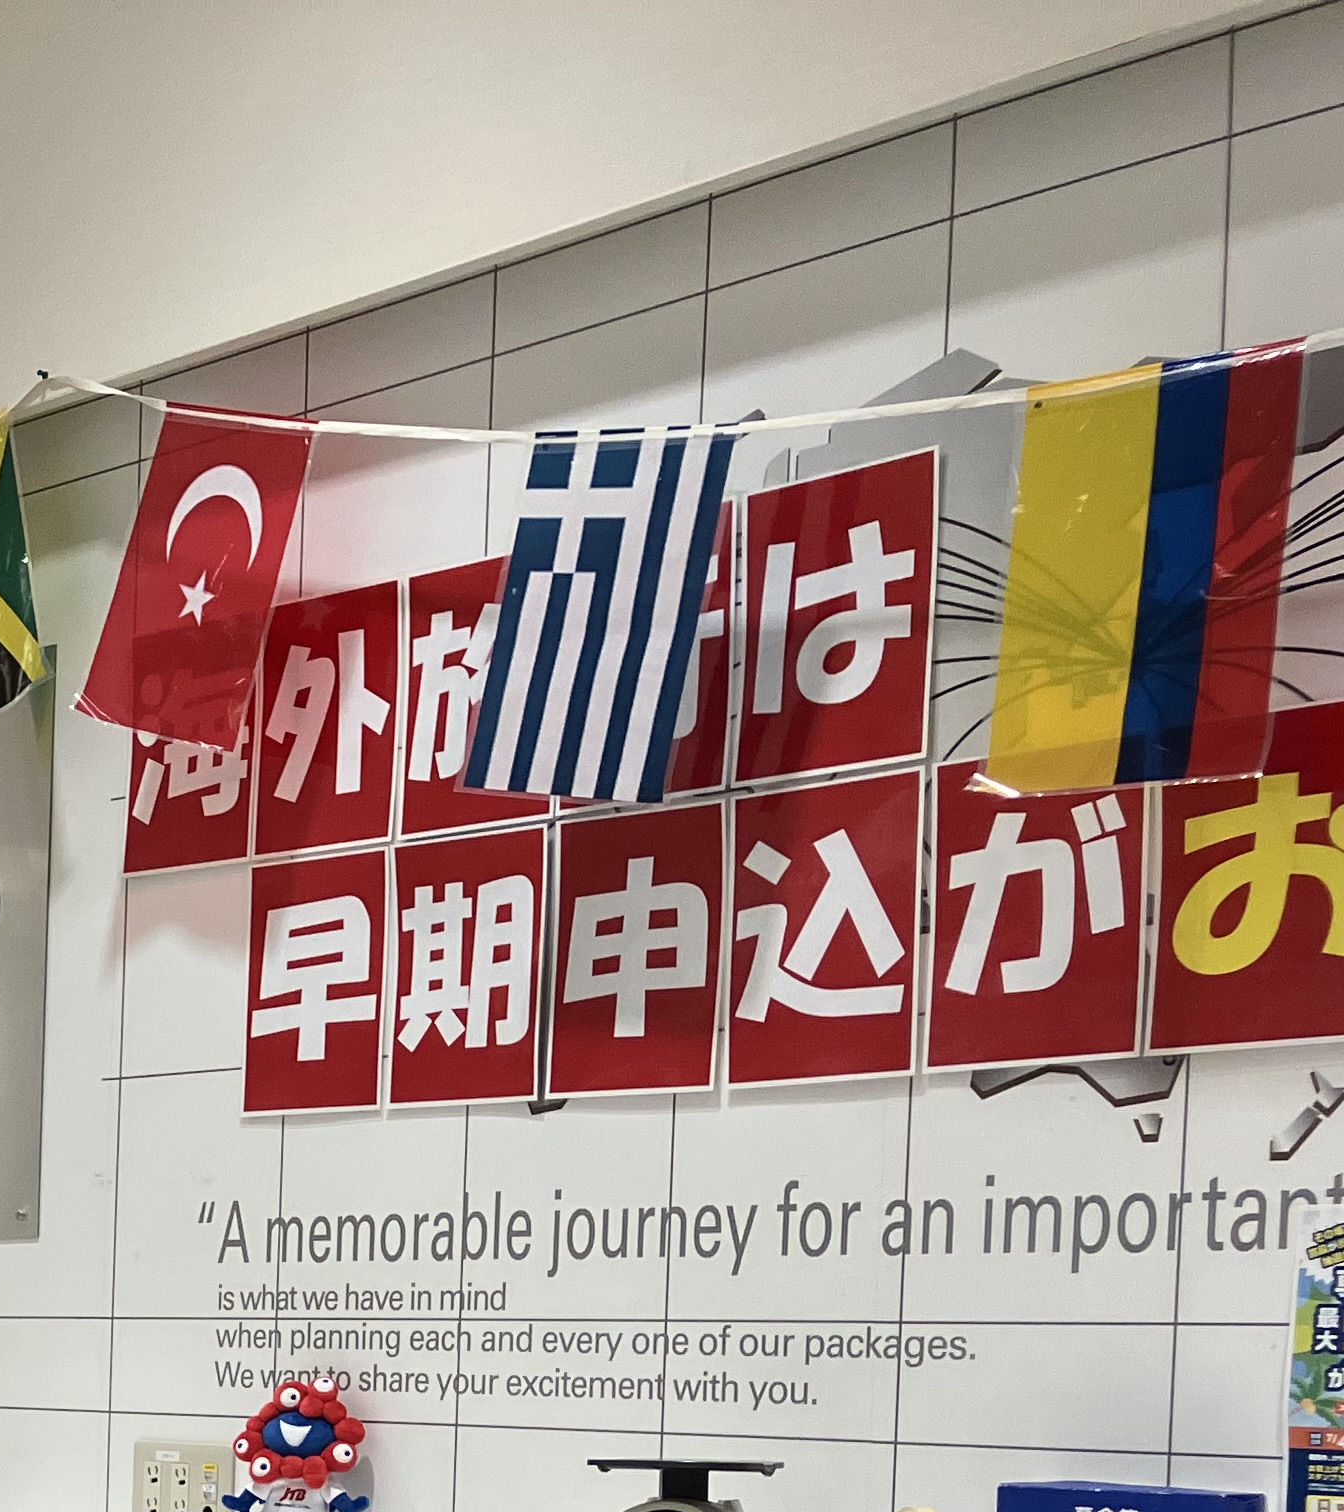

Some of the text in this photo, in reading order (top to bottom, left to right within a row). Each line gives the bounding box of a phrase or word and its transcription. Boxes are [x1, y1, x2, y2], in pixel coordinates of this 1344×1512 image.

[266, 1192, 533, 1262] memorable
[548, 1189, 759, 1277] journey
[777, 1180, 862, 1257] for
[881, 1197, 955, 1256] an
[983, 1175, 1344, 1274] importan
[217, 1282, 507, 1312] is what we have in mind
[216, 1322, 977, 1367] when planning each and every one of our packages.
[215, 1361, 255, 1390] We
[358, 1366, 430, 1394] share
[437, 1373, 499, 1400] your
[506, 1369, 665, 1401] excitement
[674, 1373, 739, 1403] with
[748, 1380, 819, 1412] you.
[279, 1487, 307, 1502] JTB
